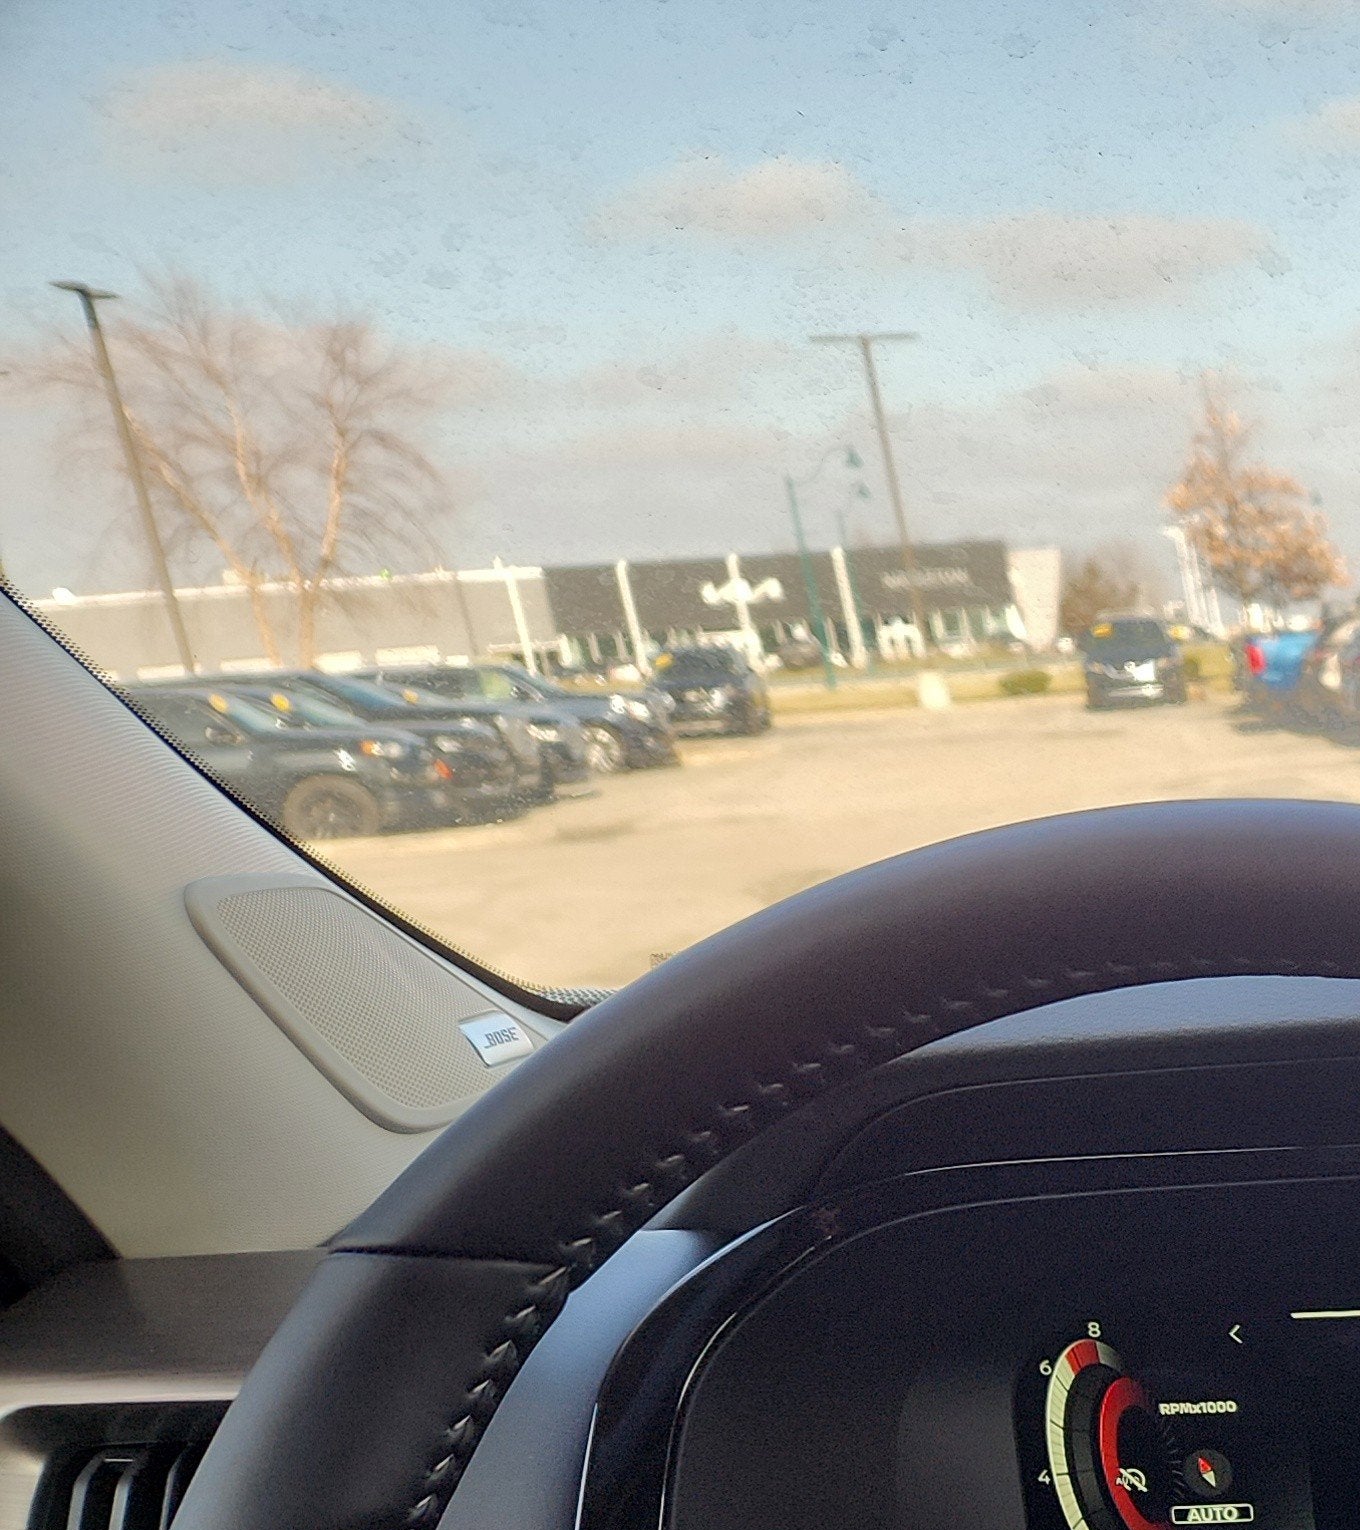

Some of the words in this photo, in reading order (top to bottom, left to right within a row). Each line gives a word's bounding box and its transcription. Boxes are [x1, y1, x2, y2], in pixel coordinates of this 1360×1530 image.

[484, 1026, 520, 1049] BOSE
[1087, 1321, 1102, 1338] 8
[1039, 1359, 1052, 1376] 6
[1158, 1400, 1238, 1416] RPMx1000
[1037, 1469, 1051, 1486] 4
[1185, 1506, 1240, 1523] AUTO
